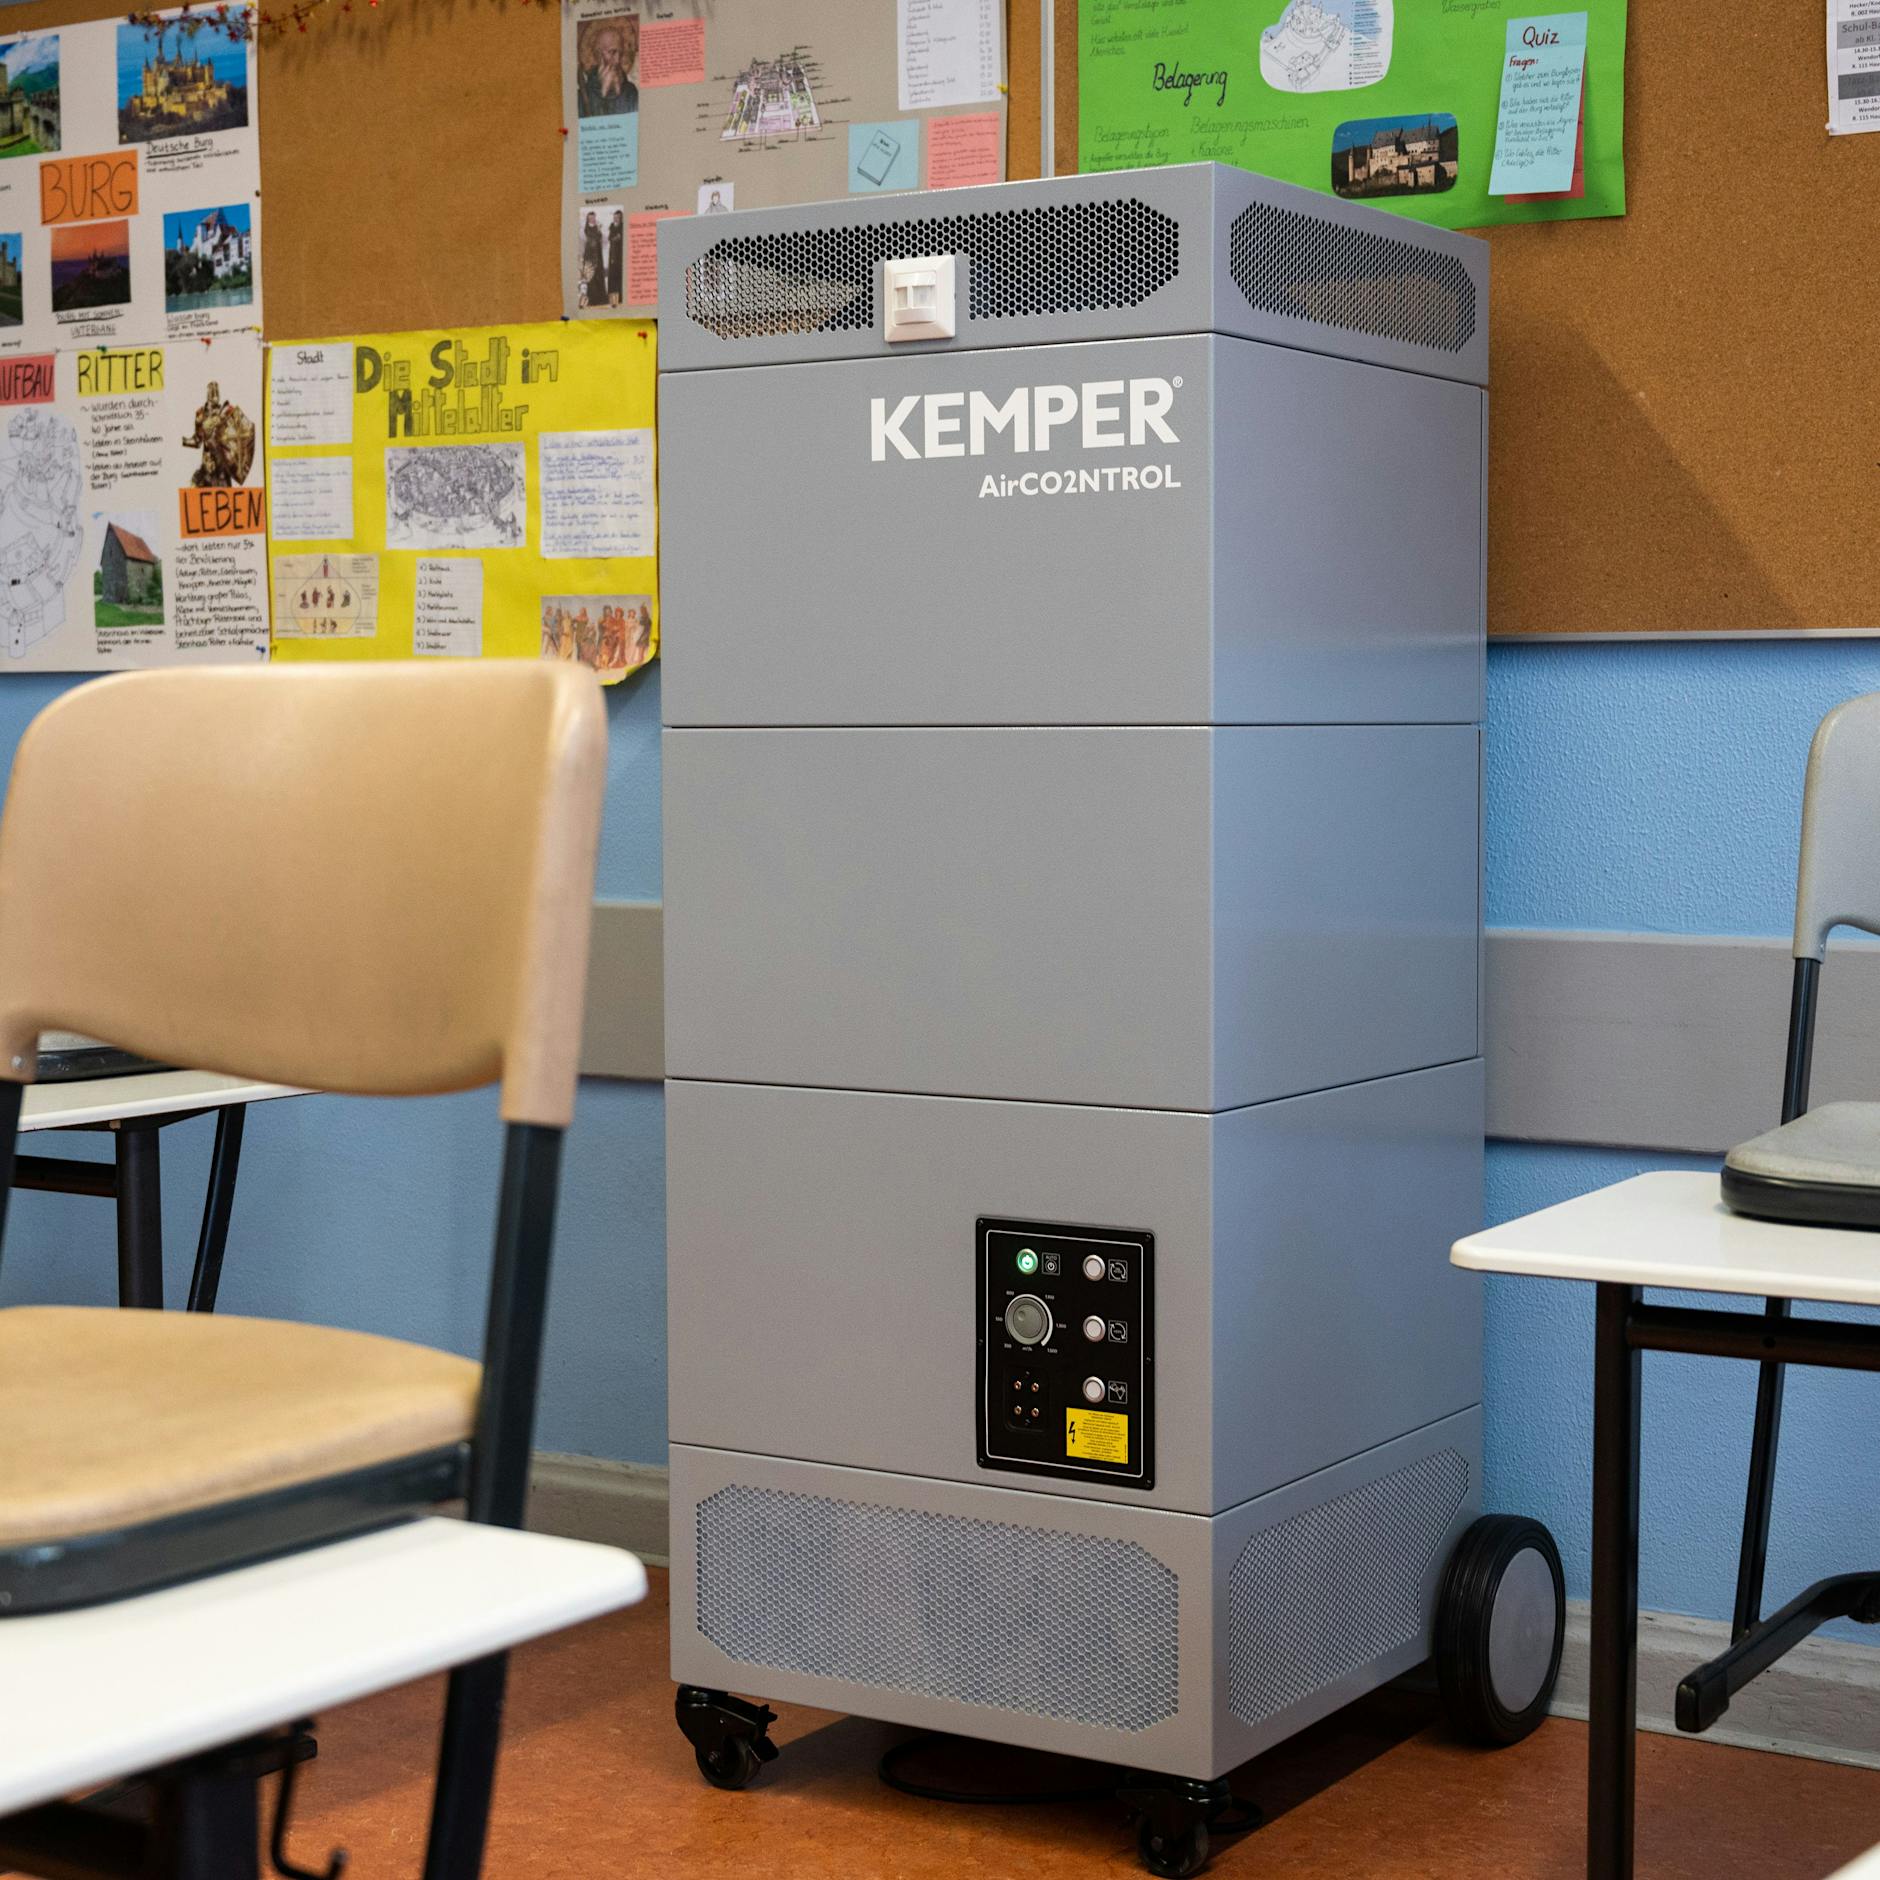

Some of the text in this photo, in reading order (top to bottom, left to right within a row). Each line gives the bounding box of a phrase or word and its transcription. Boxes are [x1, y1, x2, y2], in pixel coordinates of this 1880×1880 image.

[1523, 26, 1560, 48] Quiz
[1153, 61, 1228, 107] Belagerung
[1509, 55, 1539, 71] Fragen:
[40, 160, 136, 224] BURG
[78, 350, 164, 393] RITTER
[297, 350, 324, 365] Stadt
[356, 336, 560, 393] Die Stadt im
[0, 364, 54, 401] UFBAU
[388, 383, 530, 438] Mittelalter
[979, 464, 1181, 498] AirCO2NTROL
[182, 490, 263, 535] LEBEN
